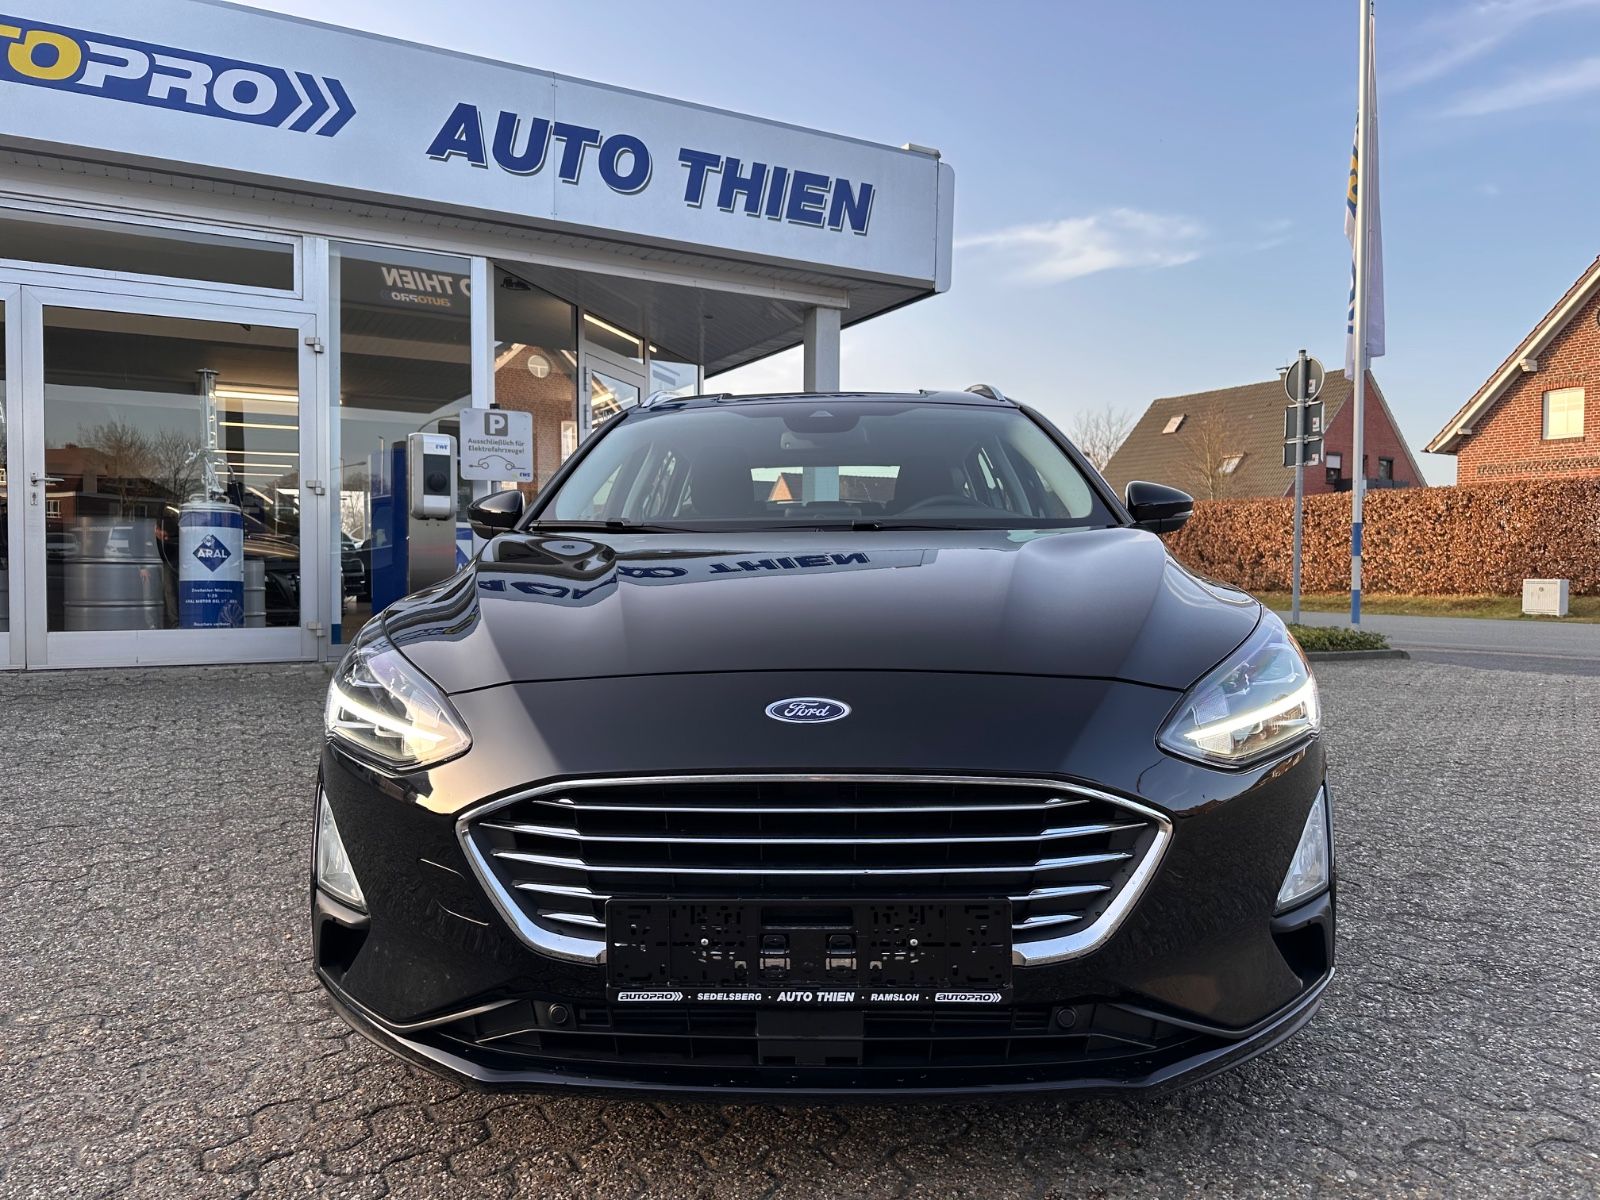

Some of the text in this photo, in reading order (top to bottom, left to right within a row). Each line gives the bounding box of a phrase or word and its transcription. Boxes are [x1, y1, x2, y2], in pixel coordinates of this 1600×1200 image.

[425, 102, 875, 236] AUTO THIEN
[489, 414, 506, 435] P
[197, 549, 228, 559] ARAL
[784, 702, 831, 717] Ford
[697, 992, 762, 1001] SEDELSBERG
[777, 991, 813, 1002] AUTO
[816, 991, 855, 1002] THIEN
[870, 993, 920, 1001] RAMSLOH
